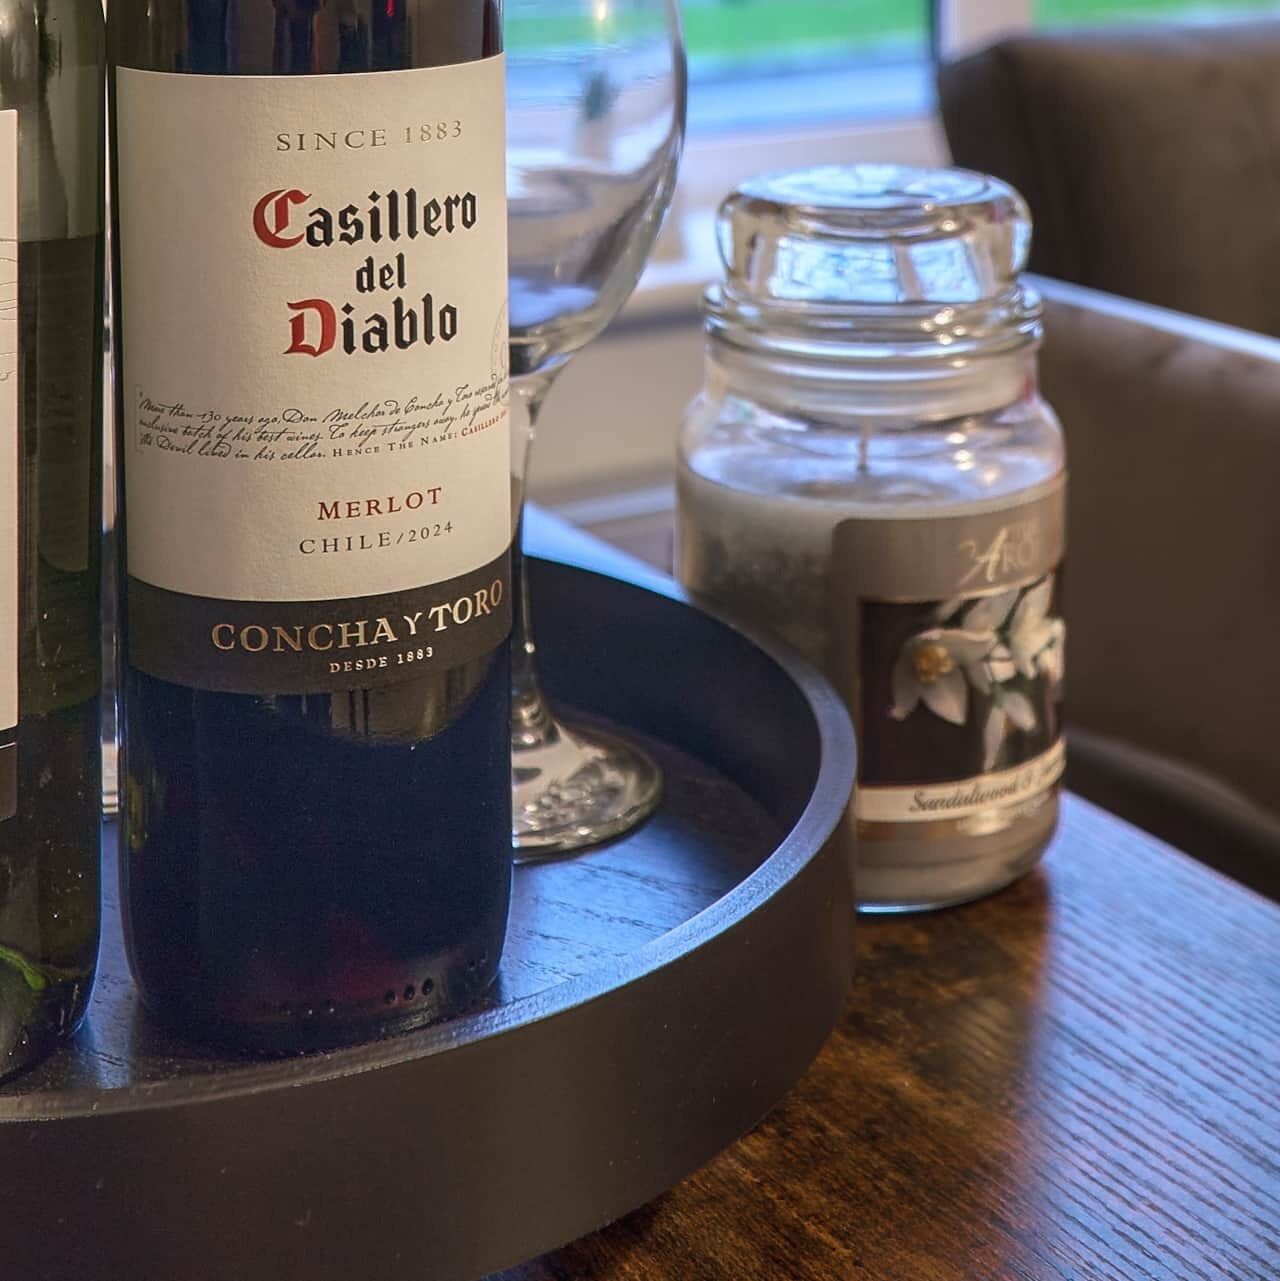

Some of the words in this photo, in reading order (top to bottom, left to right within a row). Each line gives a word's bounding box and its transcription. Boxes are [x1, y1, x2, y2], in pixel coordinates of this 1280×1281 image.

[277, 130, 387, 152] SINCE
[404, 120, 463, 144] 1883
[253, 187, 477, 249] Casillero
[356, 253, 406, 294] del
[282, 293, 458, 357] Diablo
[317, 487, 443, 521] MERLOT
[299, 521, 454, 555] CHILE/2024
[211, 618, 397, 653] CONCHA
[403, 612, 423, 636] Y
[429, 579, 504, 633] TORO
[329, 655, 388, 673] DESDE
[397, 646, 434, 665] 1883
